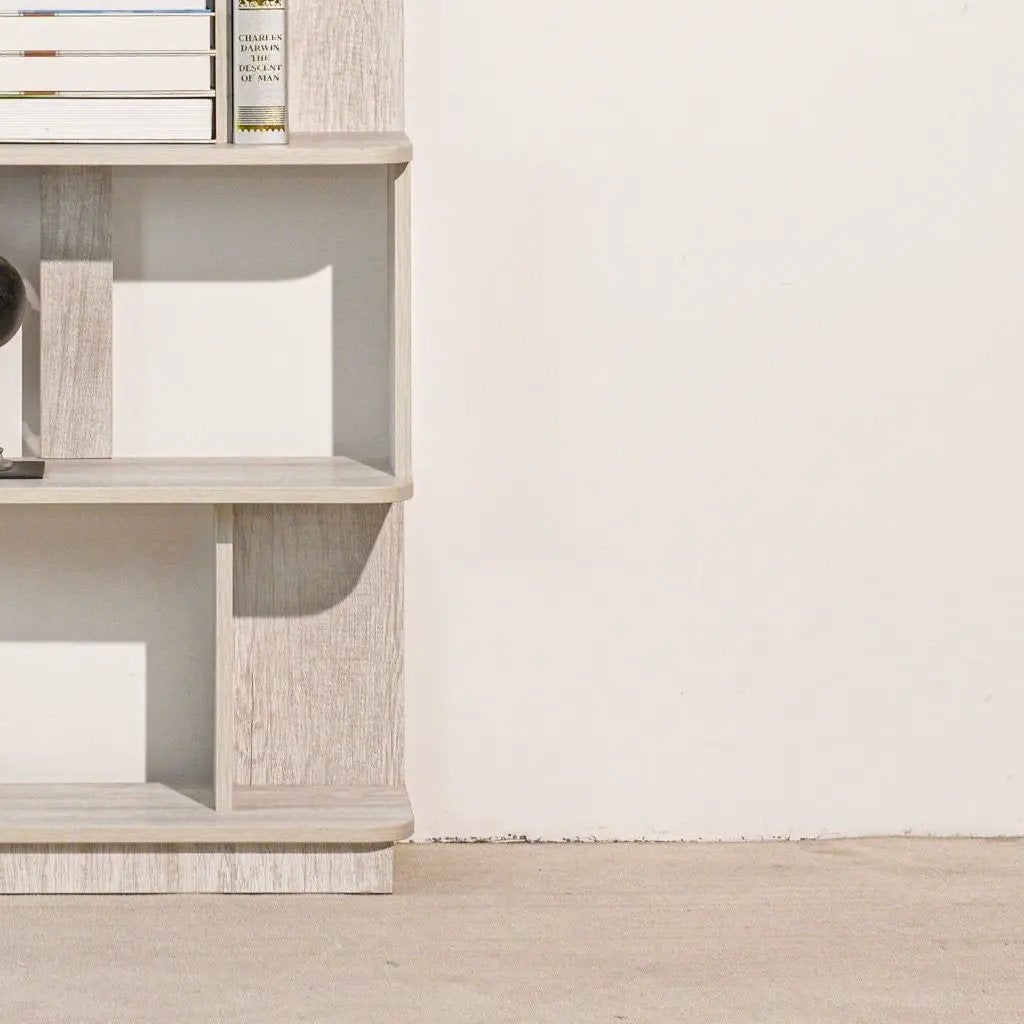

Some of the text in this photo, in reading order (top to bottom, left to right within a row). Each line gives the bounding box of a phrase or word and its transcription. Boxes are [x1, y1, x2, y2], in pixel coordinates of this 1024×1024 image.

[238, 34, 283, 42] CHARLES
[240, 44, 280, 53] DARWIN
[238, 64, 283, 72] DESCENT
[241, 74, 280, 82] OF MAN
